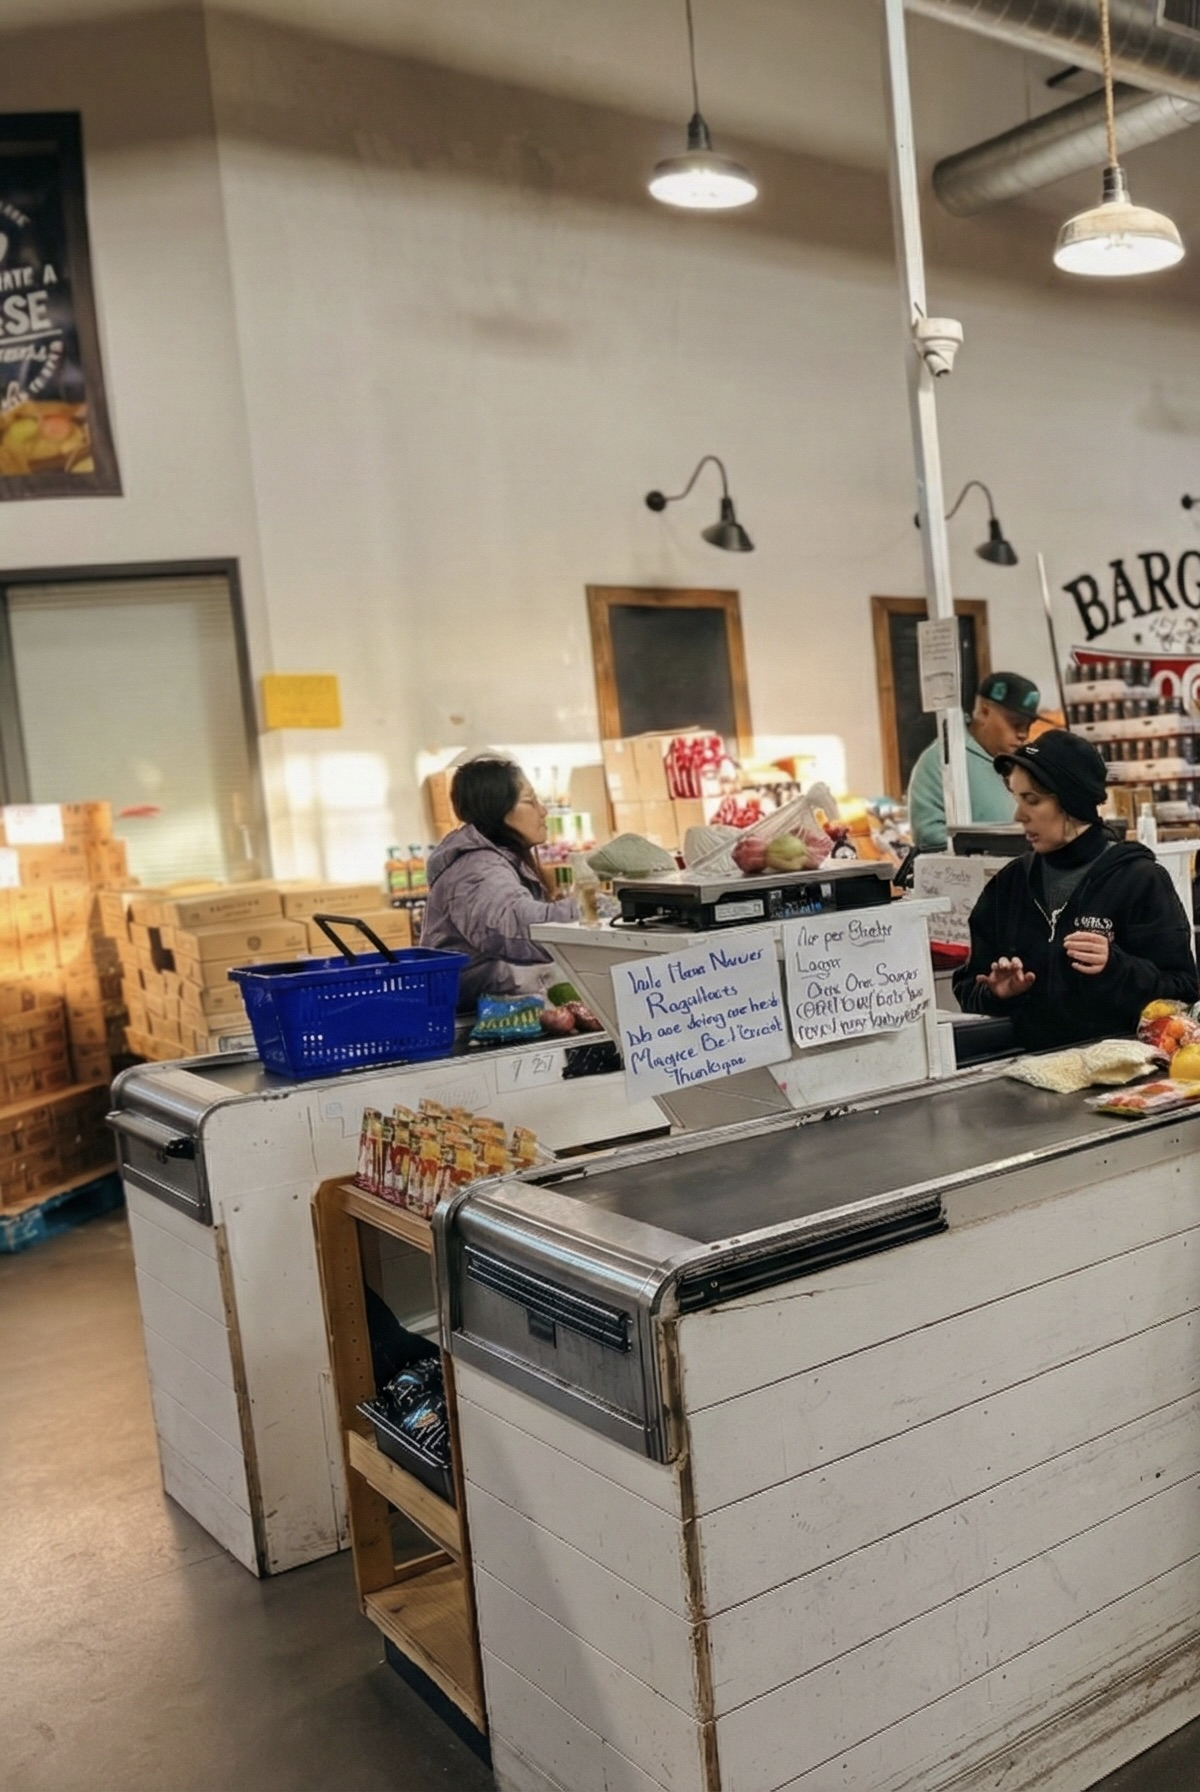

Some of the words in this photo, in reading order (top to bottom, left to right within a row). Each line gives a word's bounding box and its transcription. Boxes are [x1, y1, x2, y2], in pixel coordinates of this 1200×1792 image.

[0, 266, 33, 292] ATE
[43, 263, 58, 285] A
[0, 289, 52, 336] SE
